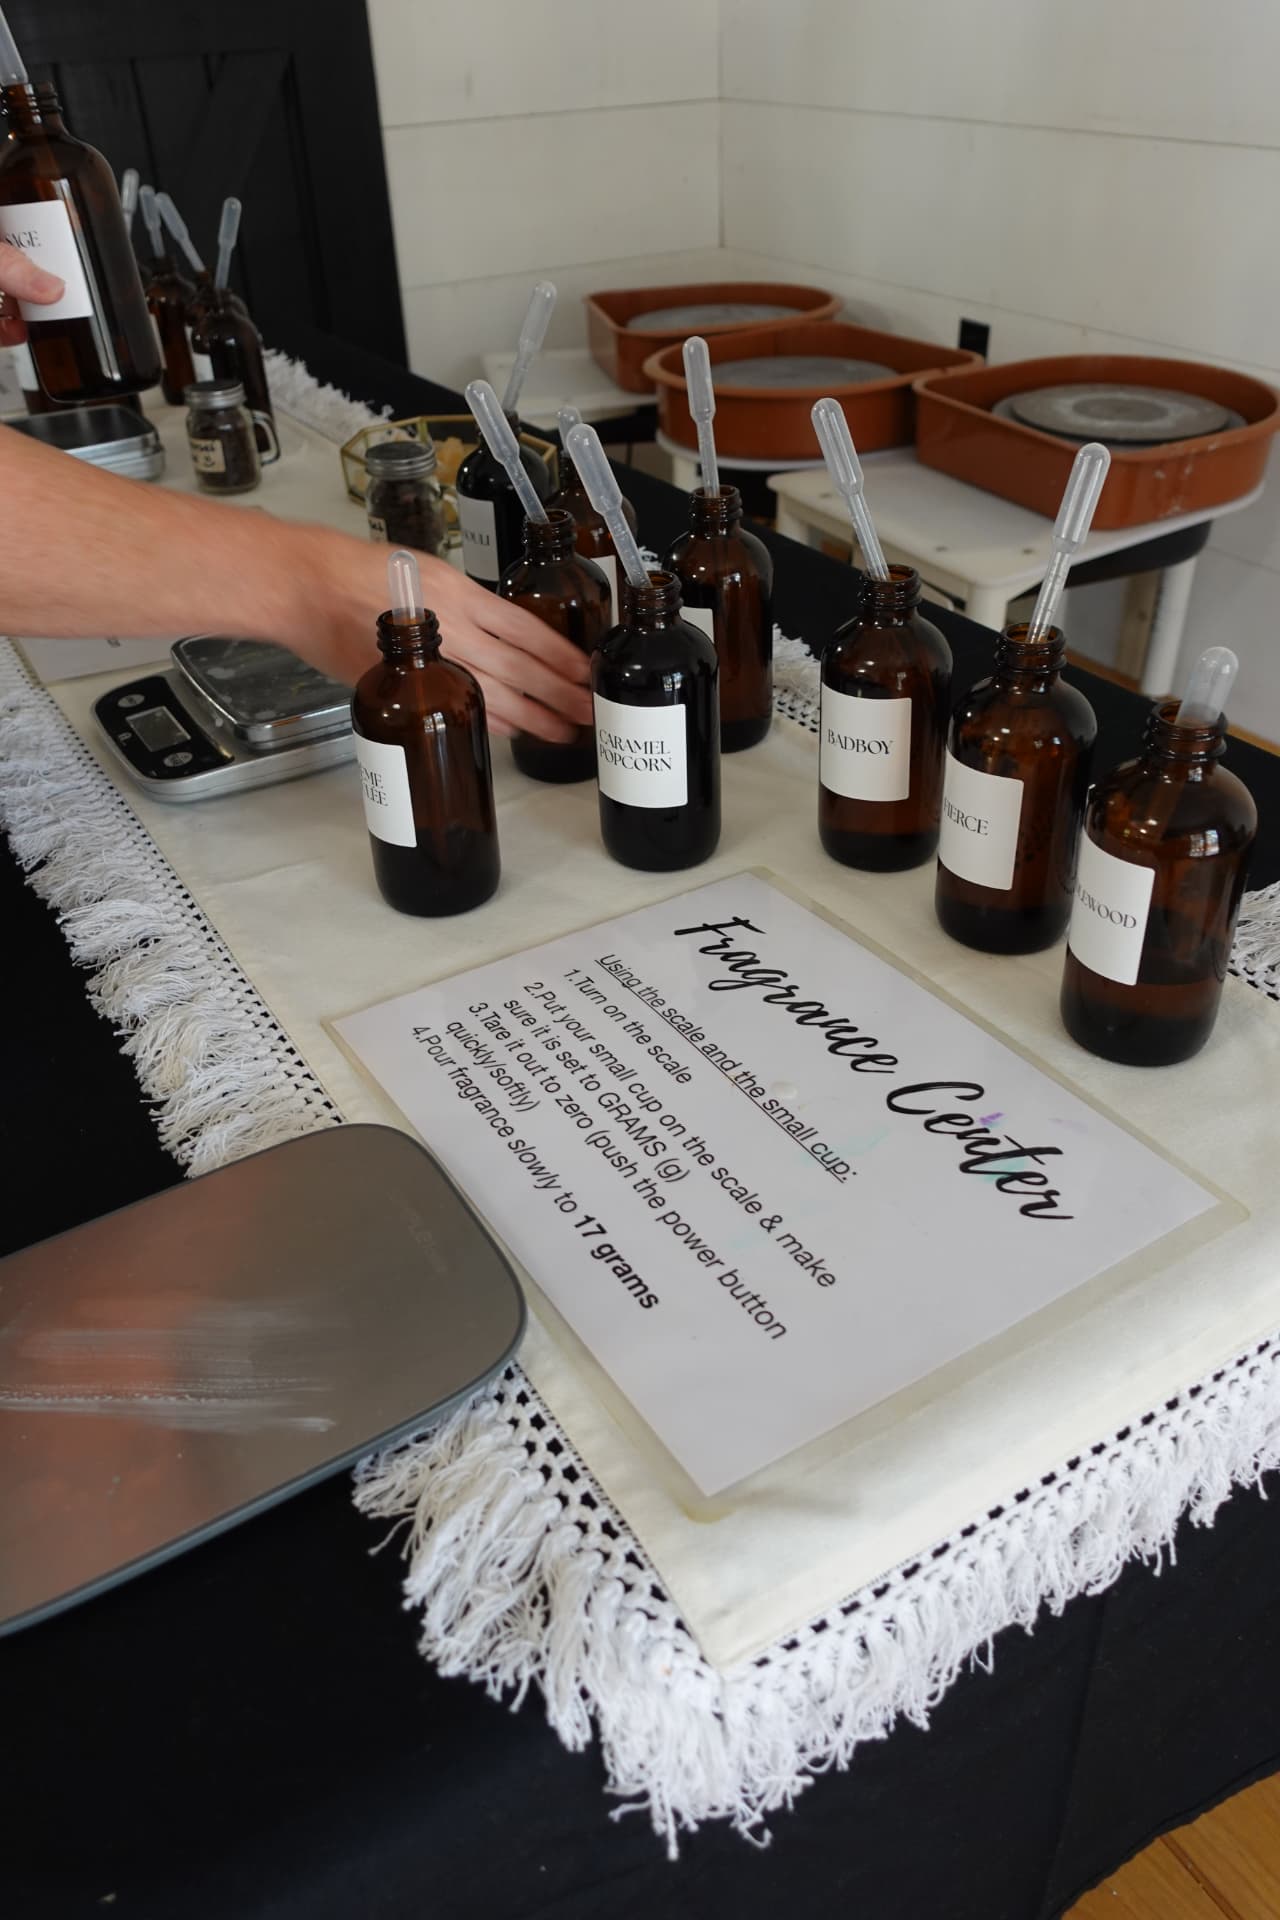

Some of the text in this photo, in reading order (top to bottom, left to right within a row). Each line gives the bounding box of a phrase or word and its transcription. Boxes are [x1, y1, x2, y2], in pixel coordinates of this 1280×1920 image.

[599, 728, 671, 755] CARAMEL
[599, 743, 672, 772] POPCORN
[827, 728, 893, 755] BADBOY
[445, 1020, 541, 1113] quickly/softly)
[597, 953, 857, 1183] Using the scale and the small cup:
[603, 1004, 628, 1023] on
[622, 1020, 652, 1045] the
[647, 1044, 692, 1084] scale
[674, 916, 1075, 1220] Fragrance Center
[447, 1066, 515, 1138] fragrance
[503, 999, 691, 1183] sure it is set to GRAMS (g)
[507, 1138, 562, 1190] slowly
[552, 1013, 597, 1042] your
[588, 1043, 639, 1082] small
[628, 1082, 664, 1113] cup
[659, 1114, 687, 1138] on
[682, 1135, 715, 1167] the
[710, 1167, 763, 1214] scale
[759, 1214, 783, 1234] &
[775, 1233, 836, 1288] make
[504, 1037, 526, 1053] it
[516, 1051, 549, 1078] out
[539, 1074, 562, 1094] to
[554, 1093, 594, 1130] zero
[583, 1129, 638, 1179] (push
[632, 1177, 666, 1210] the
[655, 1209, 725, 1268] power
[716, 1268, 788, 1340] button
[553, 1190, 578, 1213] to
[573, 1214, 608, 1238] 17
[590, 1242, 660, 1310] grams
